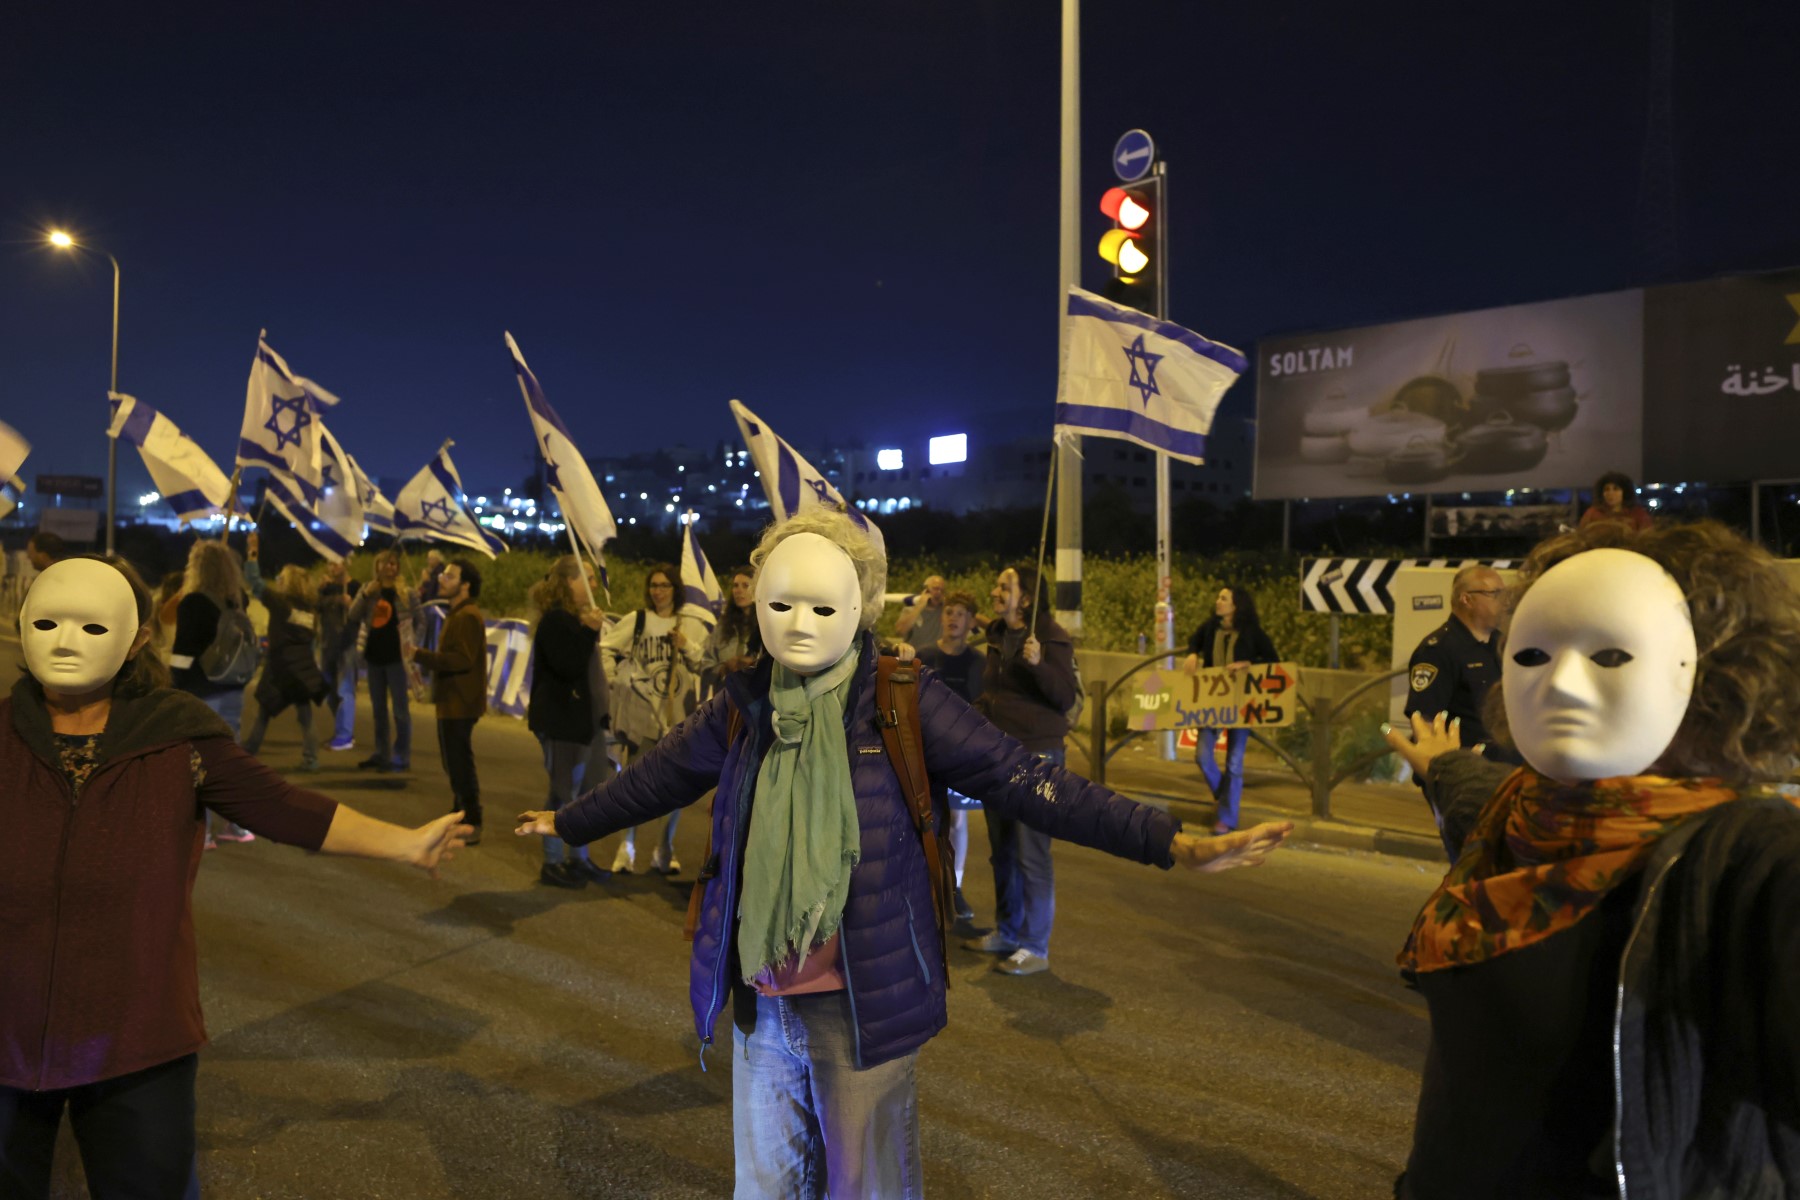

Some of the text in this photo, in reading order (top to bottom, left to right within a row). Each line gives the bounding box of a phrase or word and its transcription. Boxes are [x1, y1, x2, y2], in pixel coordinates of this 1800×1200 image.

[1270, 346, 1353, 376] SOLTAM
[1721, 363, 1800, 396] اخنة
[1192, 663, 1286, 703] לא ימין
[1135, 693, 1170, 710] ישר
[1175, 699, 1284, 727] לא שמאל
